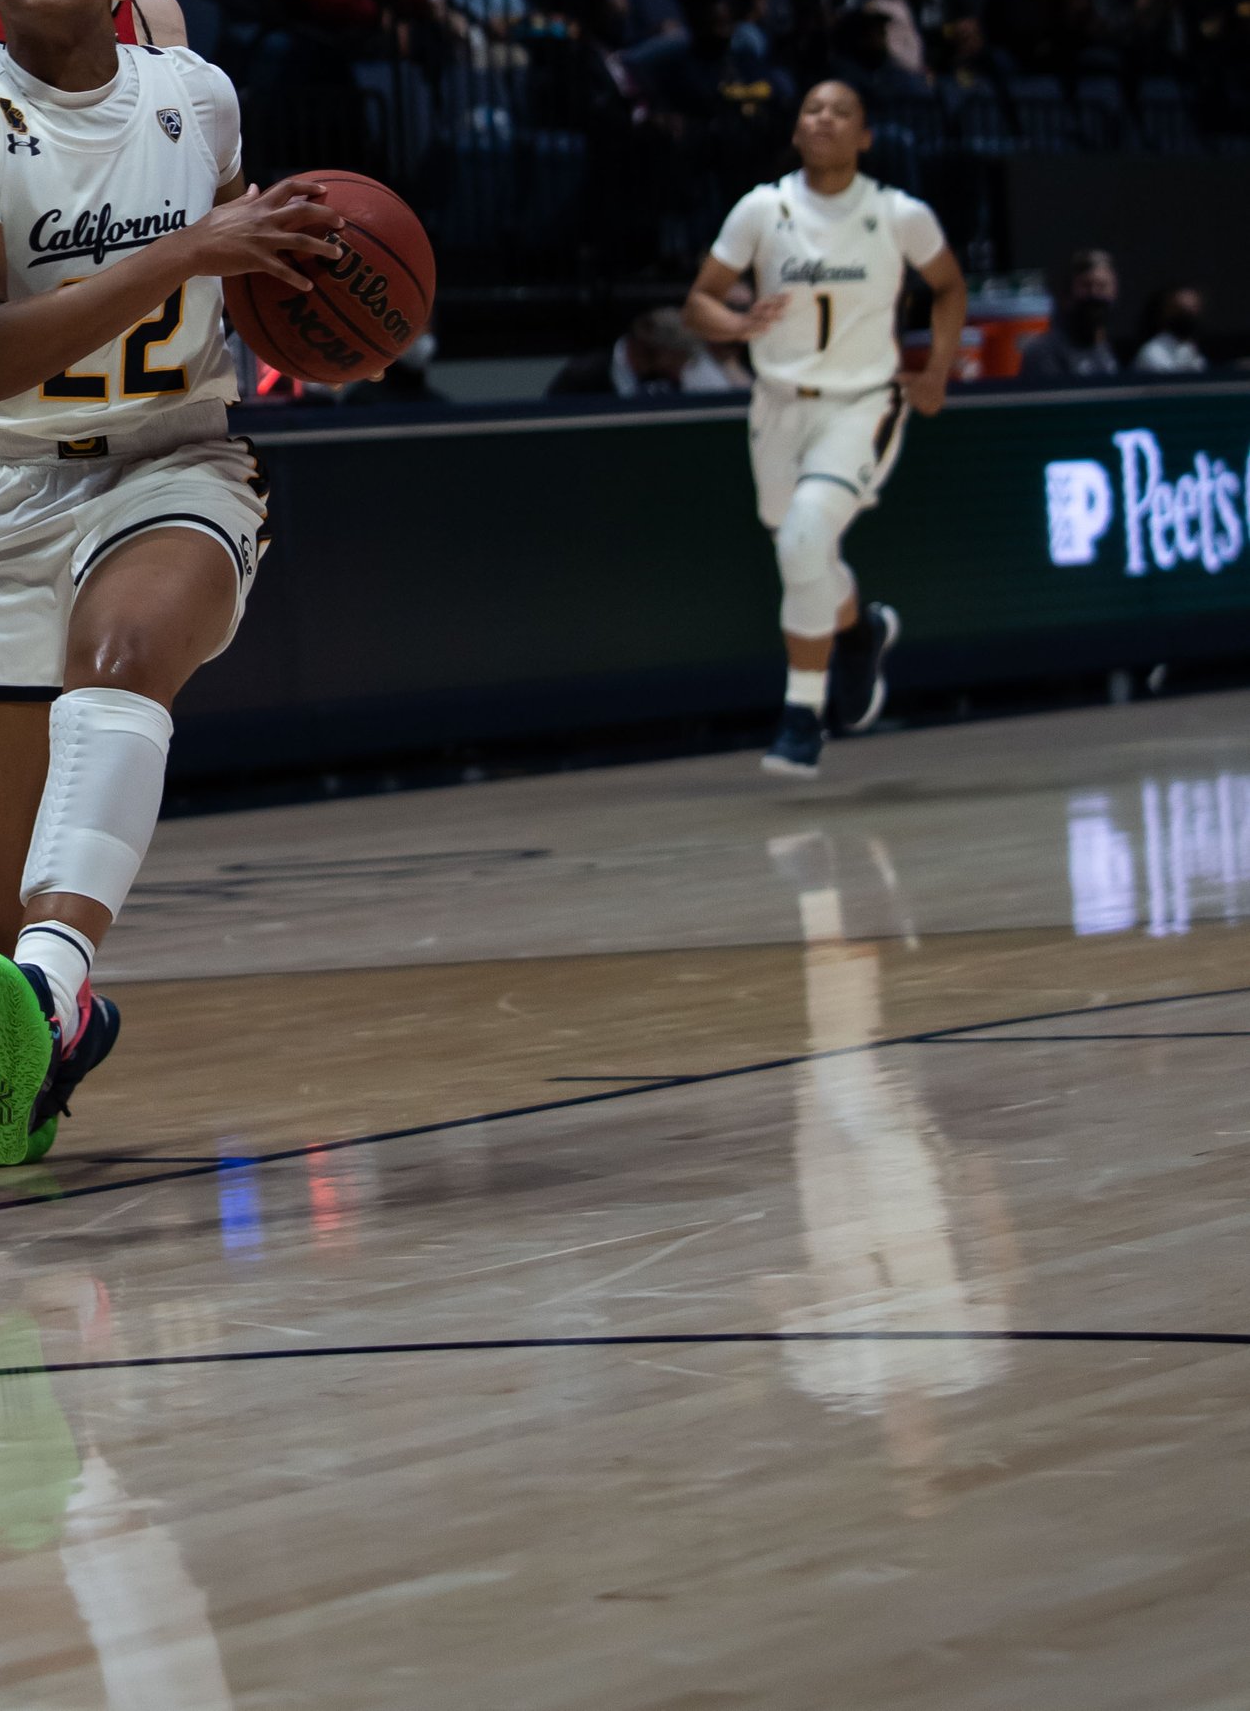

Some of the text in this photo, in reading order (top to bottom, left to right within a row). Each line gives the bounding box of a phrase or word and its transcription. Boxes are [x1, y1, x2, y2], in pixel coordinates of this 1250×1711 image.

[28, 200, 186, 268] California
[815, 294, 831, 353] 1
[1111, 427, 1244, 578] Peet's
